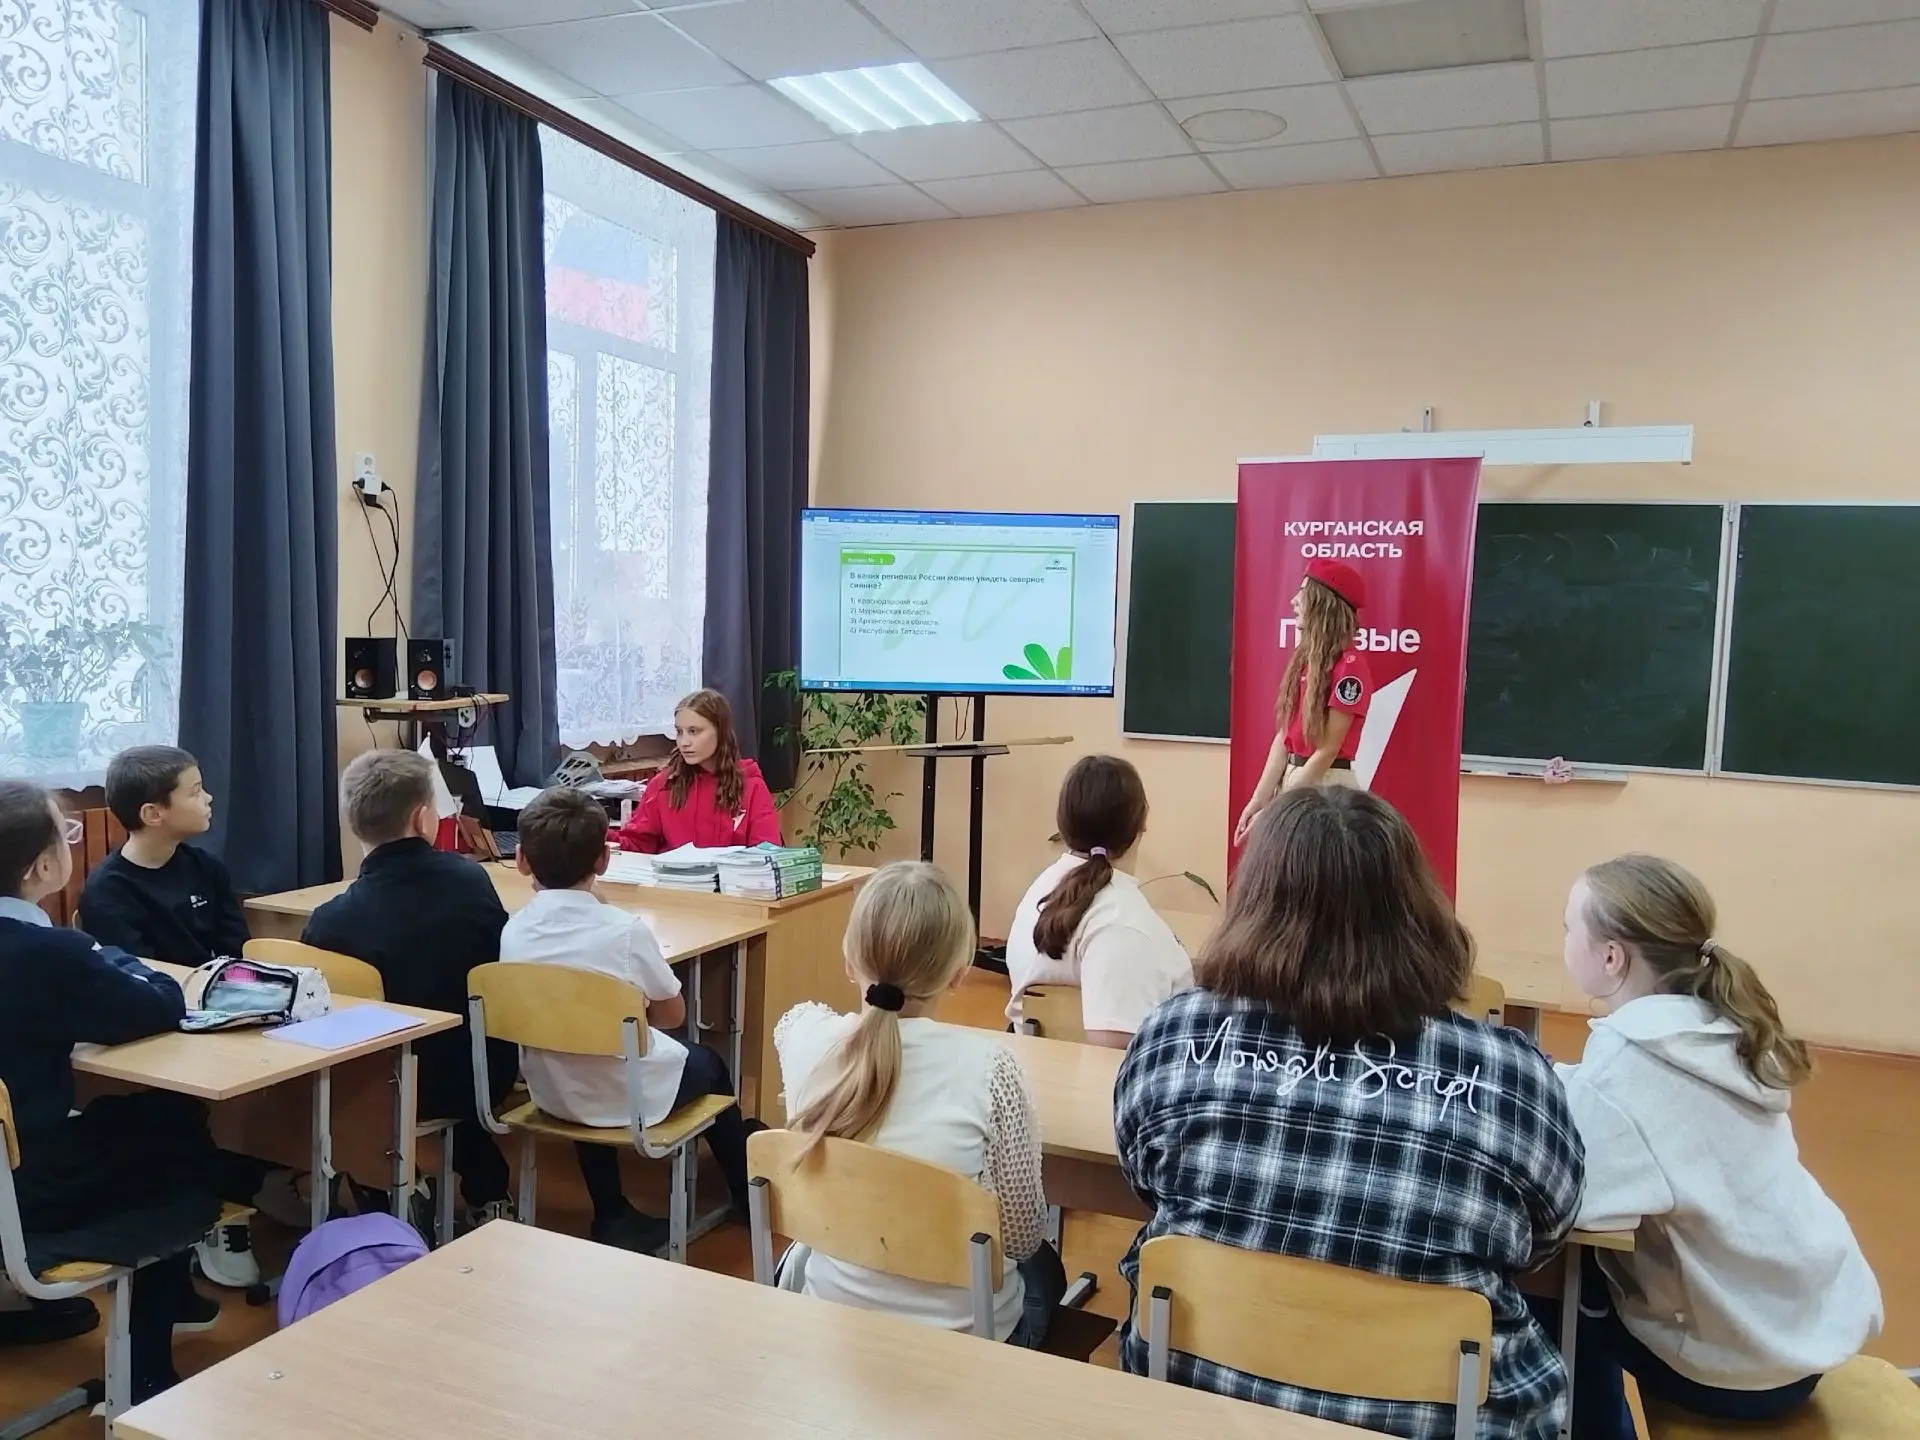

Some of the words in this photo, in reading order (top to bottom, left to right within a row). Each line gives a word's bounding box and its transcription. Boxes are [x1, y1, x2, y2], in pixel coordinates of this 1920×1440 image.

[1284, 520, 1424, 536] КУРГАНСКАЯ
[1301, 542, 1403, 558] ОБЛАСТЬ
[881, 574, 917, 582] регионах
[918, 573, 946, 581] России
[976, 576, 1008, 584] увидеть
[1279, 618, 1421, 654] Пвые
[1183, 1016, 1341, 1096] Mowgli
[1353, 1031, 1503, 1122] Script
